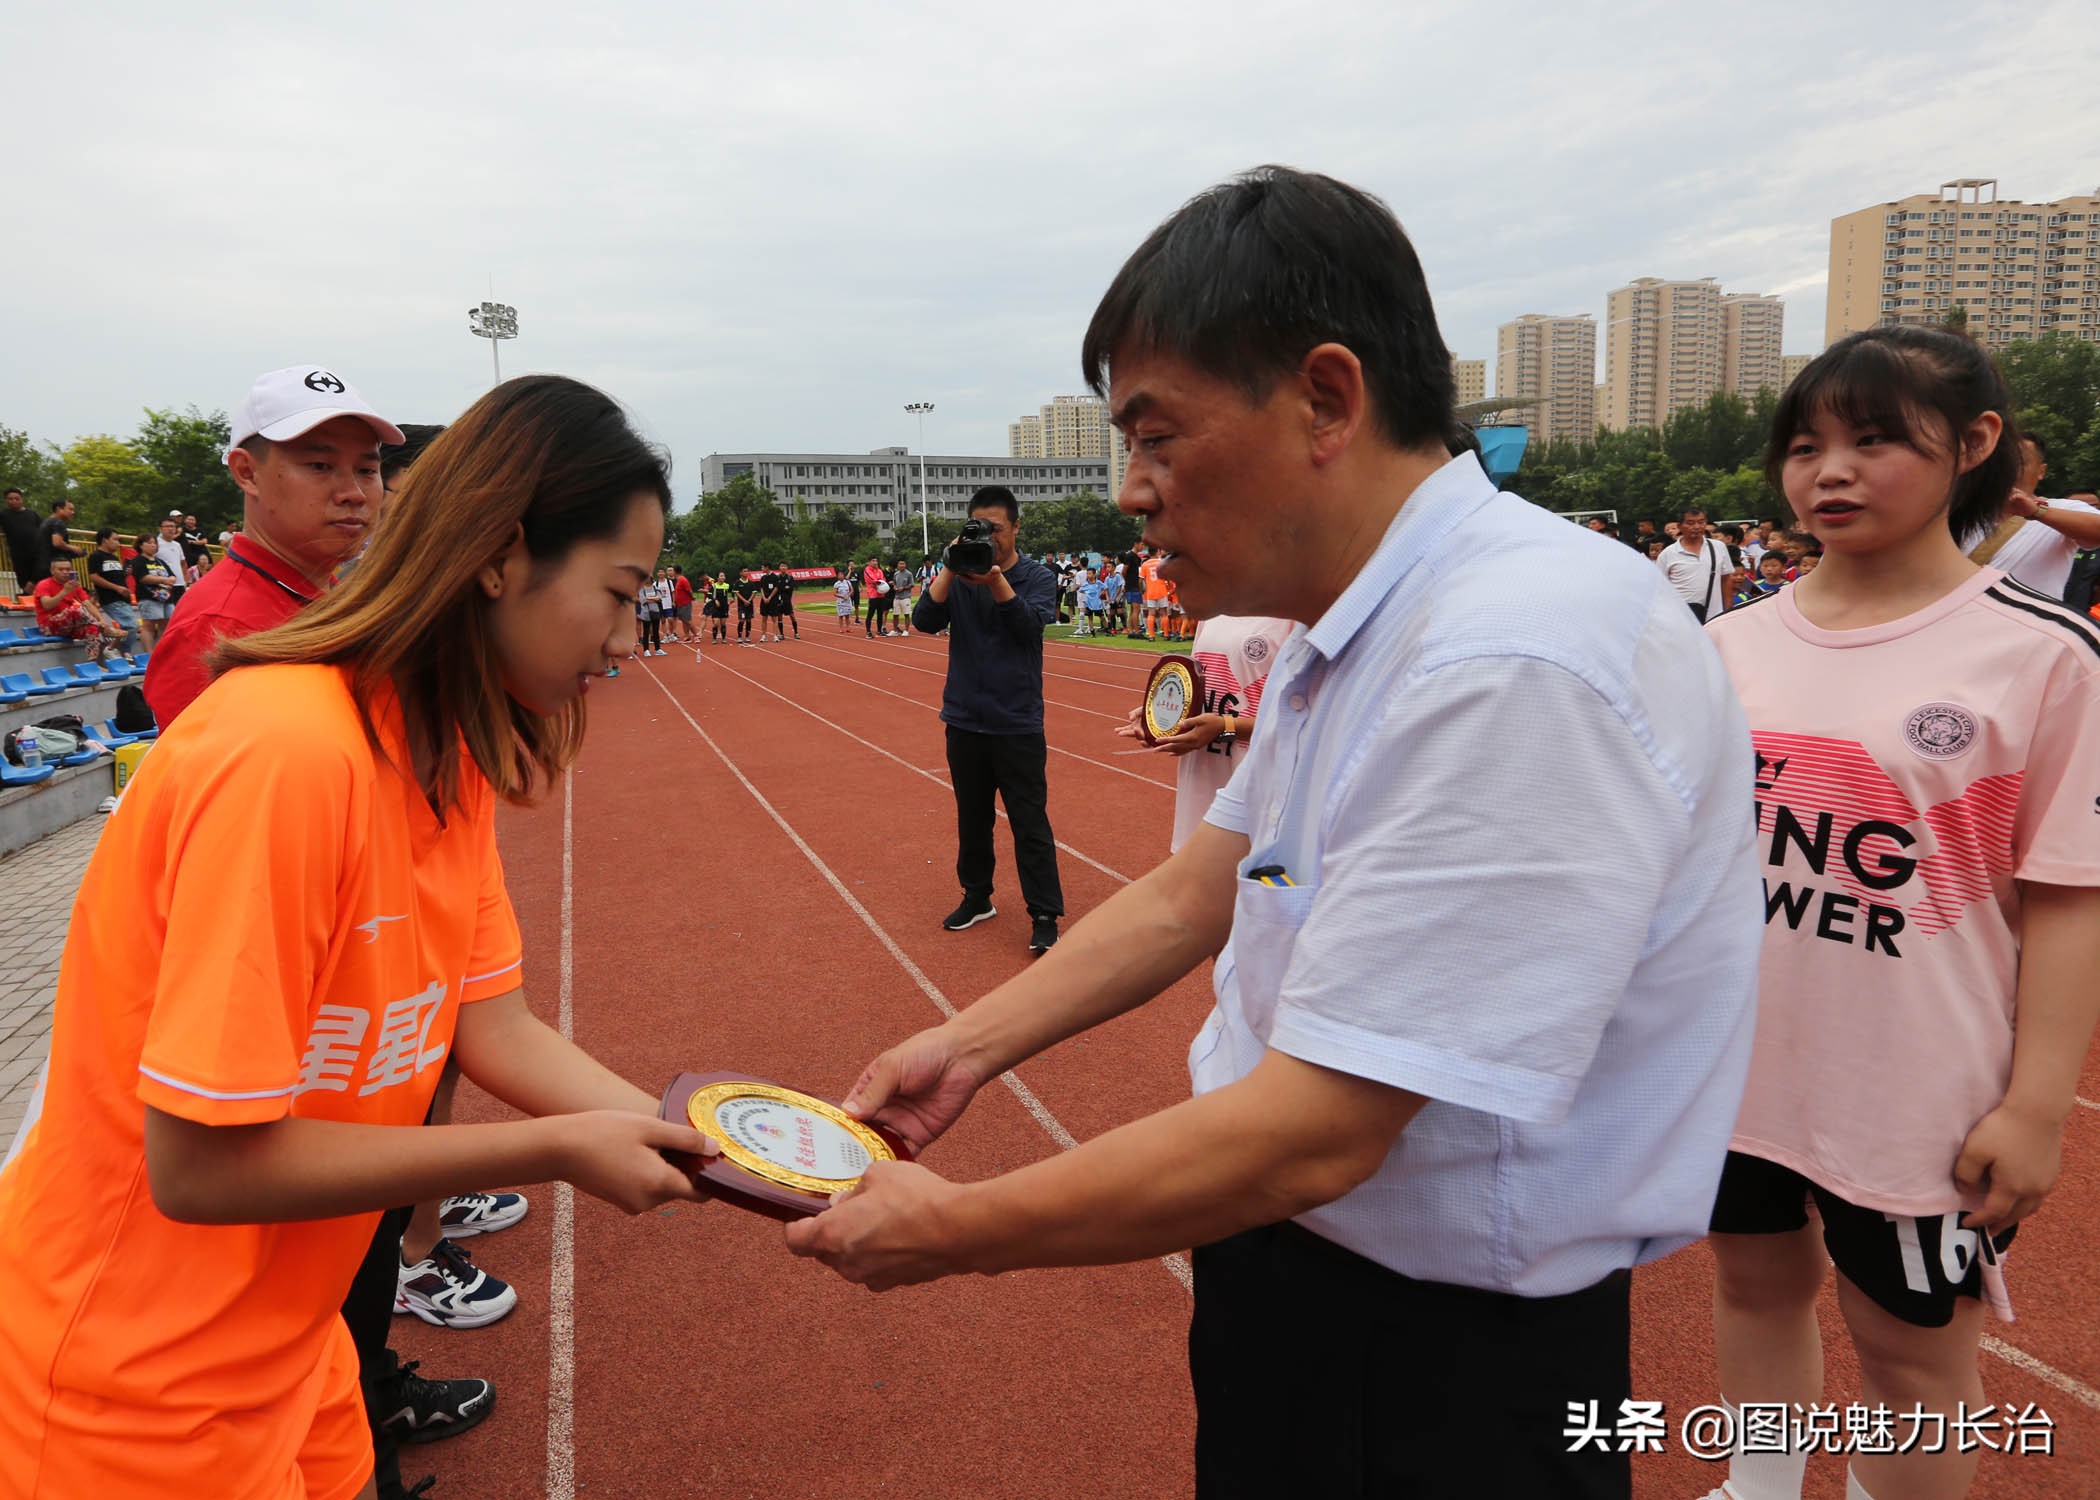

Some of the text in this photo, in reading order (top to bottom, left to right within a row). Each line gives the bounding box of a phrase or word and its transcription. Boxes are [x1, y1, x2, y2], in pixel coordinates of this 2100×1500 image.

[1916, 708, 1965, 722] LEICESTER
[1909, 724, 1967, 754] FOOTBALL CLUB
